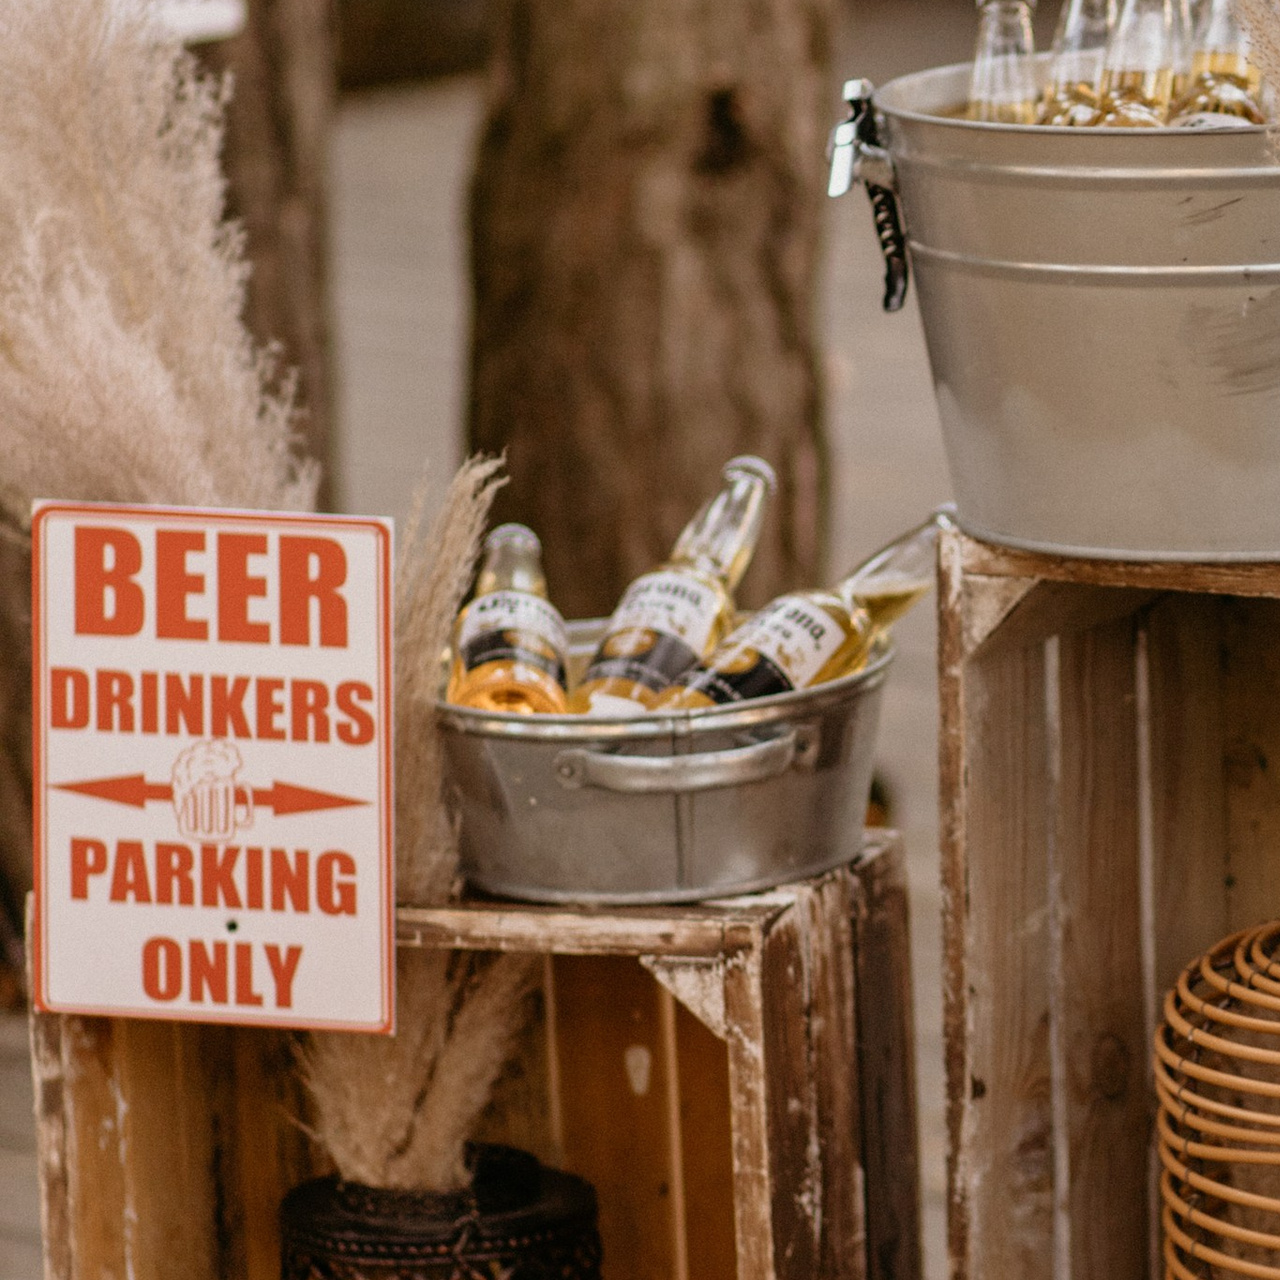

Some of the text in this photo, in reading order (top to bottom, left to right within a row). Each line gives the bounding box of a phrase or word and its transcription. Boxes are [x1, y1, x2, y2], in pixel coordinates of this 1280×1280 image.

[74, 525, 348, 648] BEER
[50, 667, 375, 746] DRINKERS
[70, 837, 358, 916] PARKING
[141, 936, 303, 1008] ONLY
